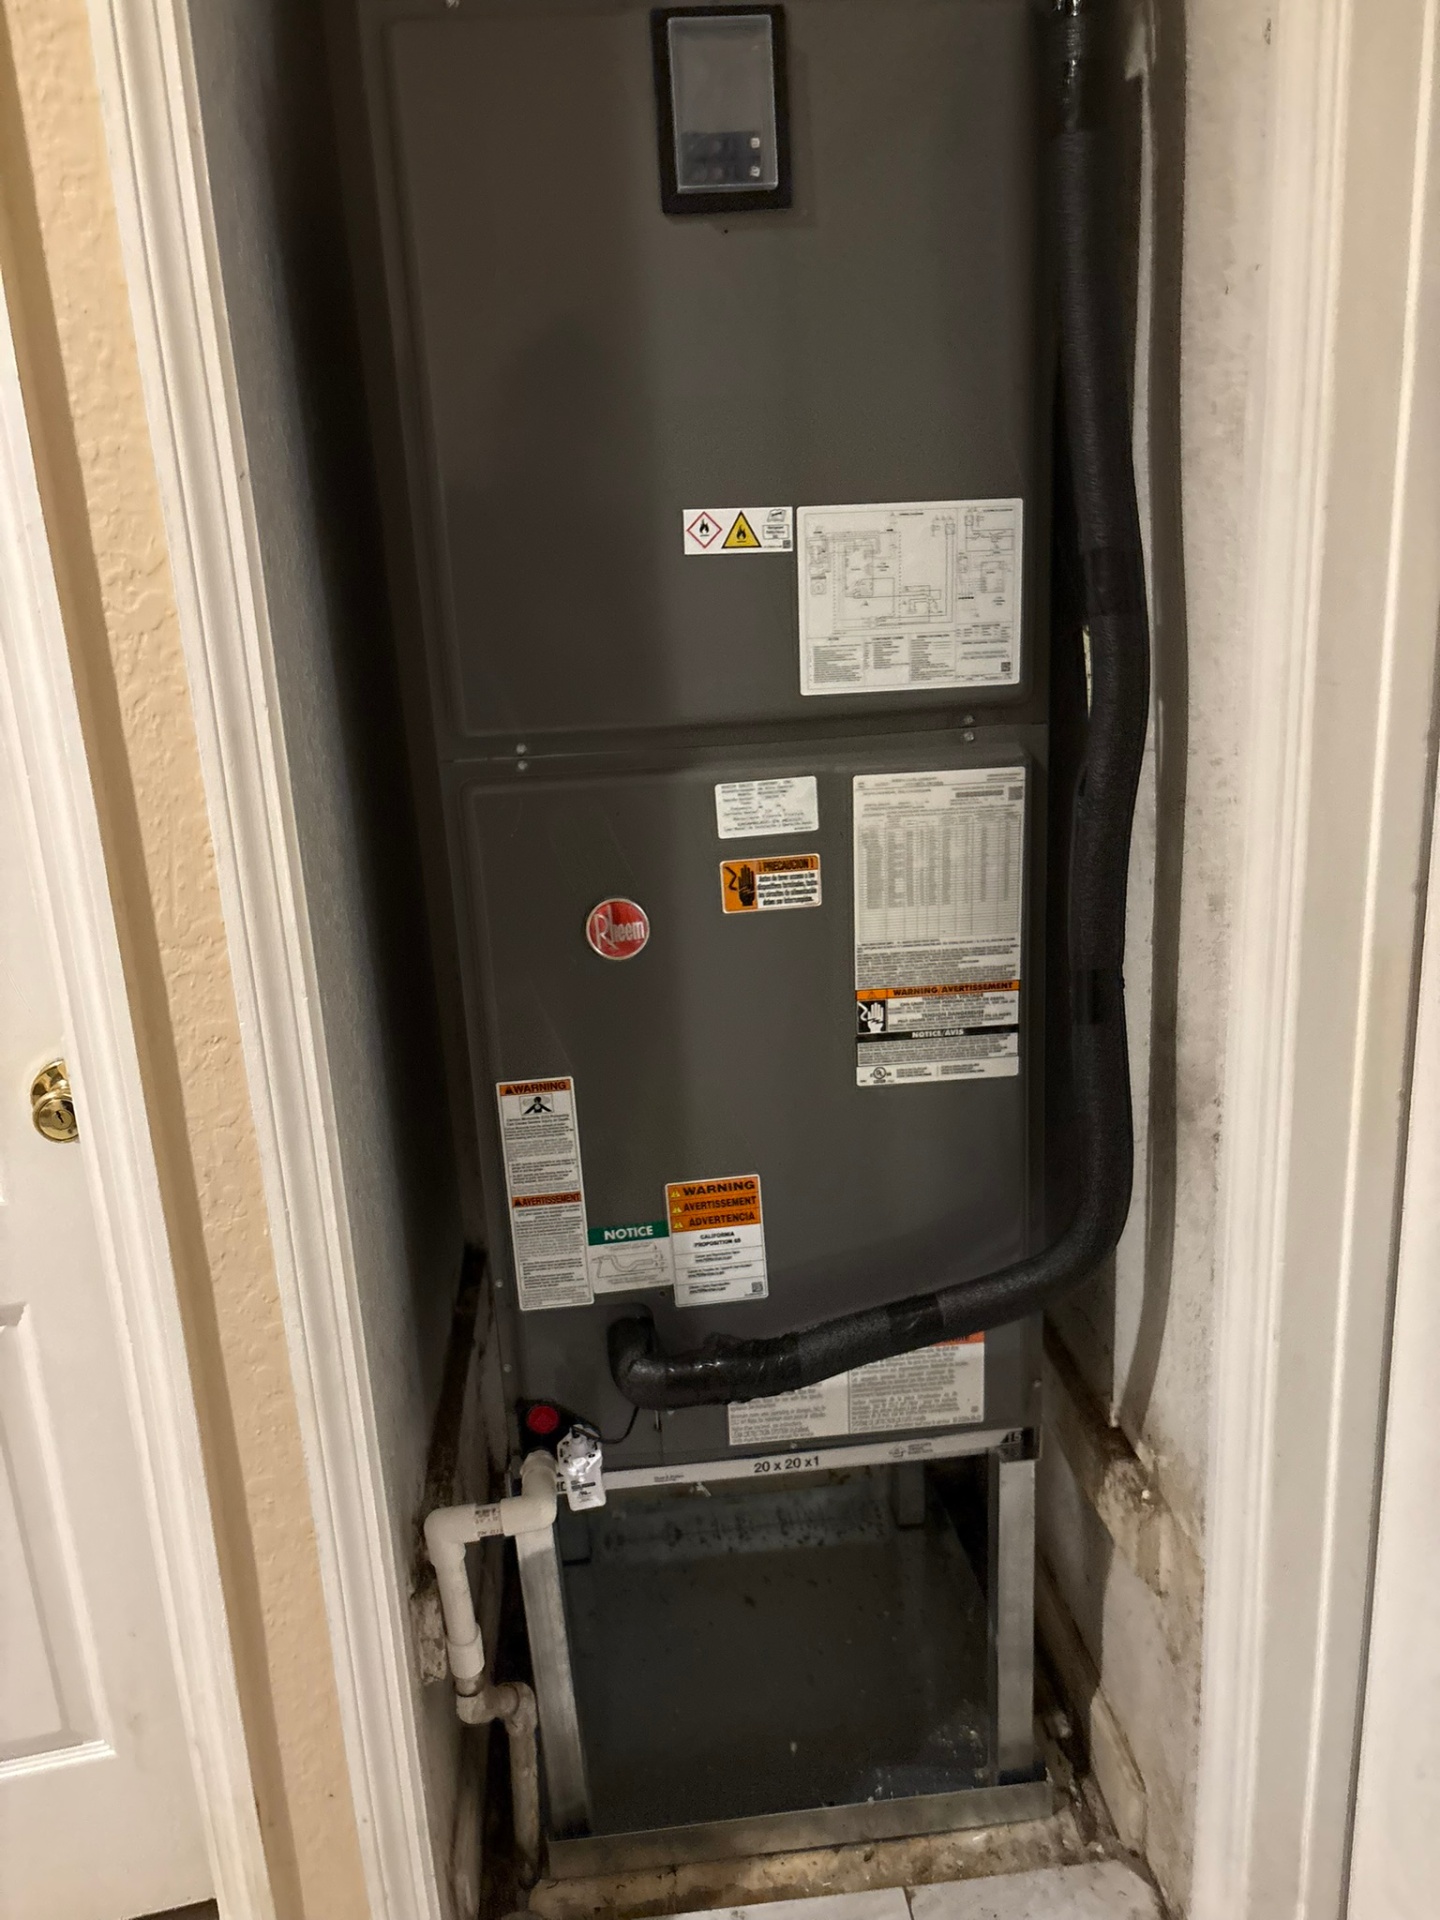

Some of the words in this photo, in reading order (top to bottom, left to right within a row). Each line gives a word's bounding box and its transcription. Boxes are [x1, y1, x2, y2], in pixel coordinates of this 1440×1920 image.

[593, 904, 645, 950] Rheem
[512, 1081, 566, 1094] WARNING
[683, 1180, 755, 1196] WARNING
[684, 1196, 757, 1211] AVERTISSEMENT
[689, 1212, 755, 1227] ADVERTENCIA
[604, 1225, 654, 1240] NOTICE
[754, 1461, 771, 1473] 20
[774, 1462, 781, 1471] x
[785, 1458, 801, 1469] 20
